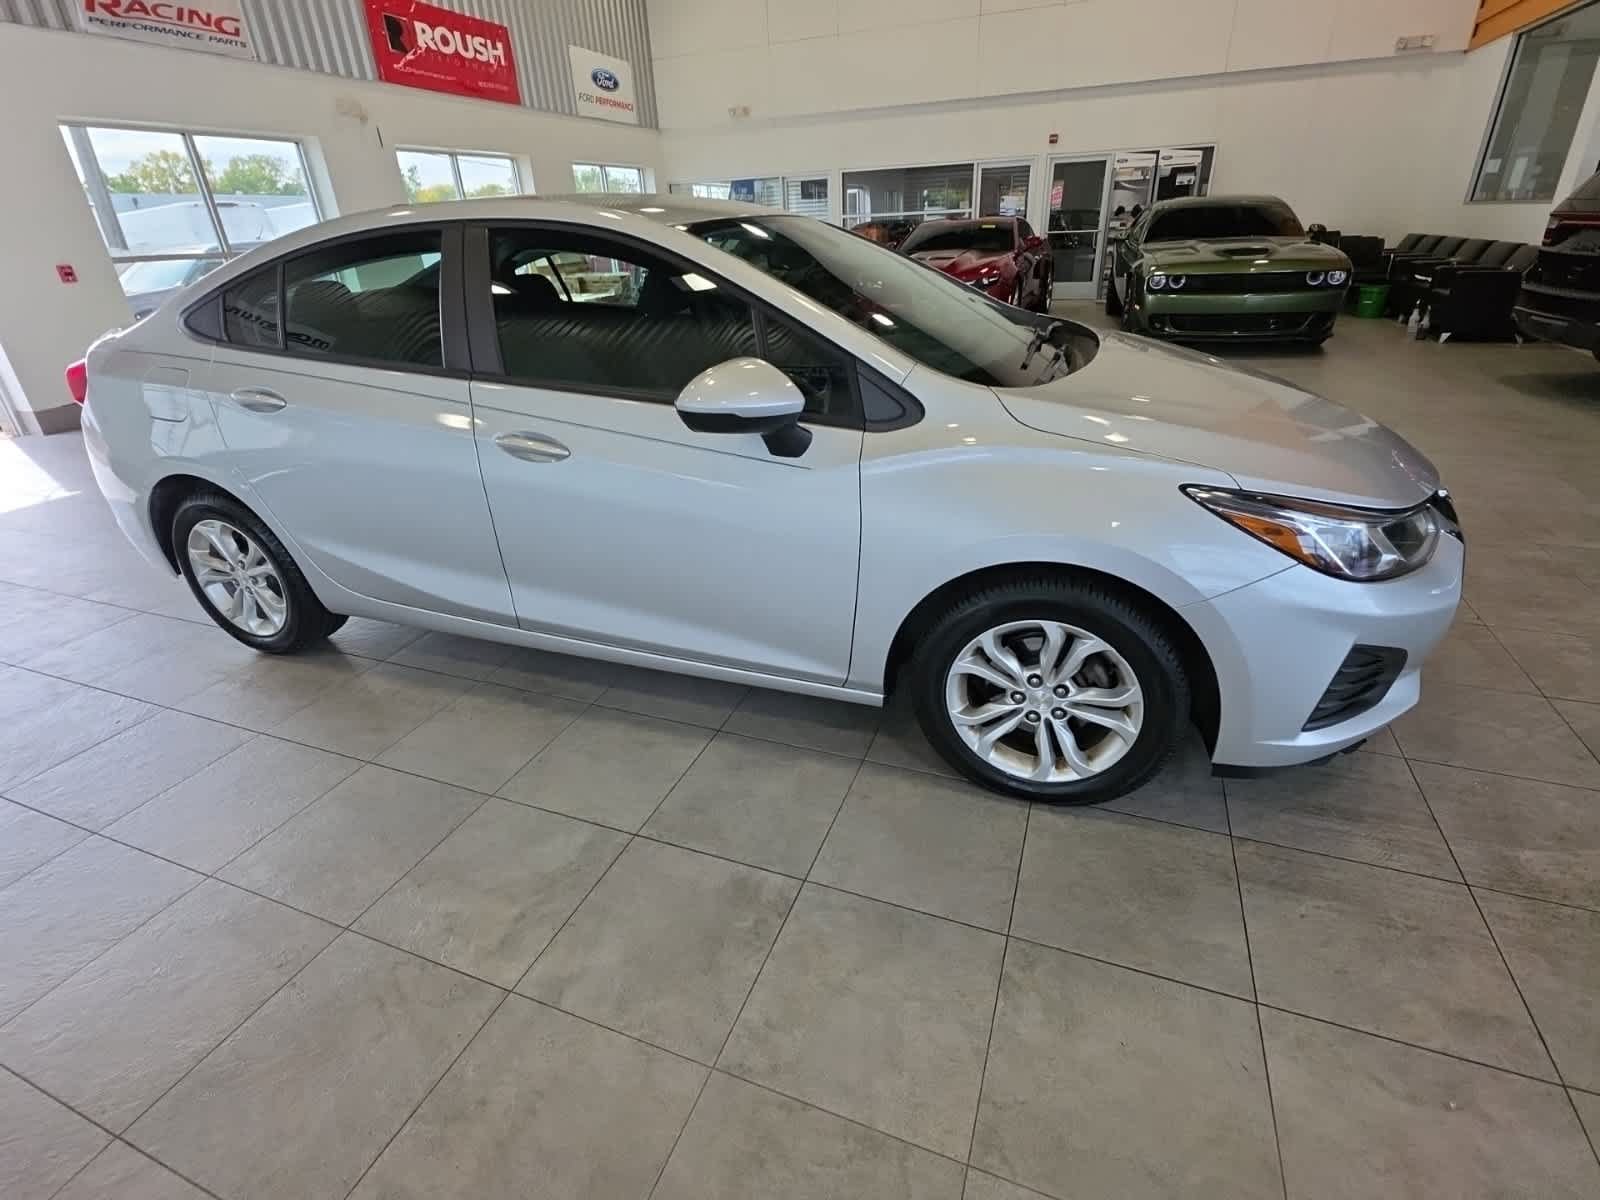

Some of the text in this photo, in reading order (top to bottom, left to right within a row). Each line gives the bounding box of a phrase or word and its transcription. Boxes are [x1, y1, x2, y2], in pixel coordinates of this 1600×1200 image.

[84, 0, 240, 37] RACING
[88, 15, 247, 49] PERFORMANCE PARTS
[413, 20, 506, 67] ROUSH
[594, 70, 617, 90] Ford
